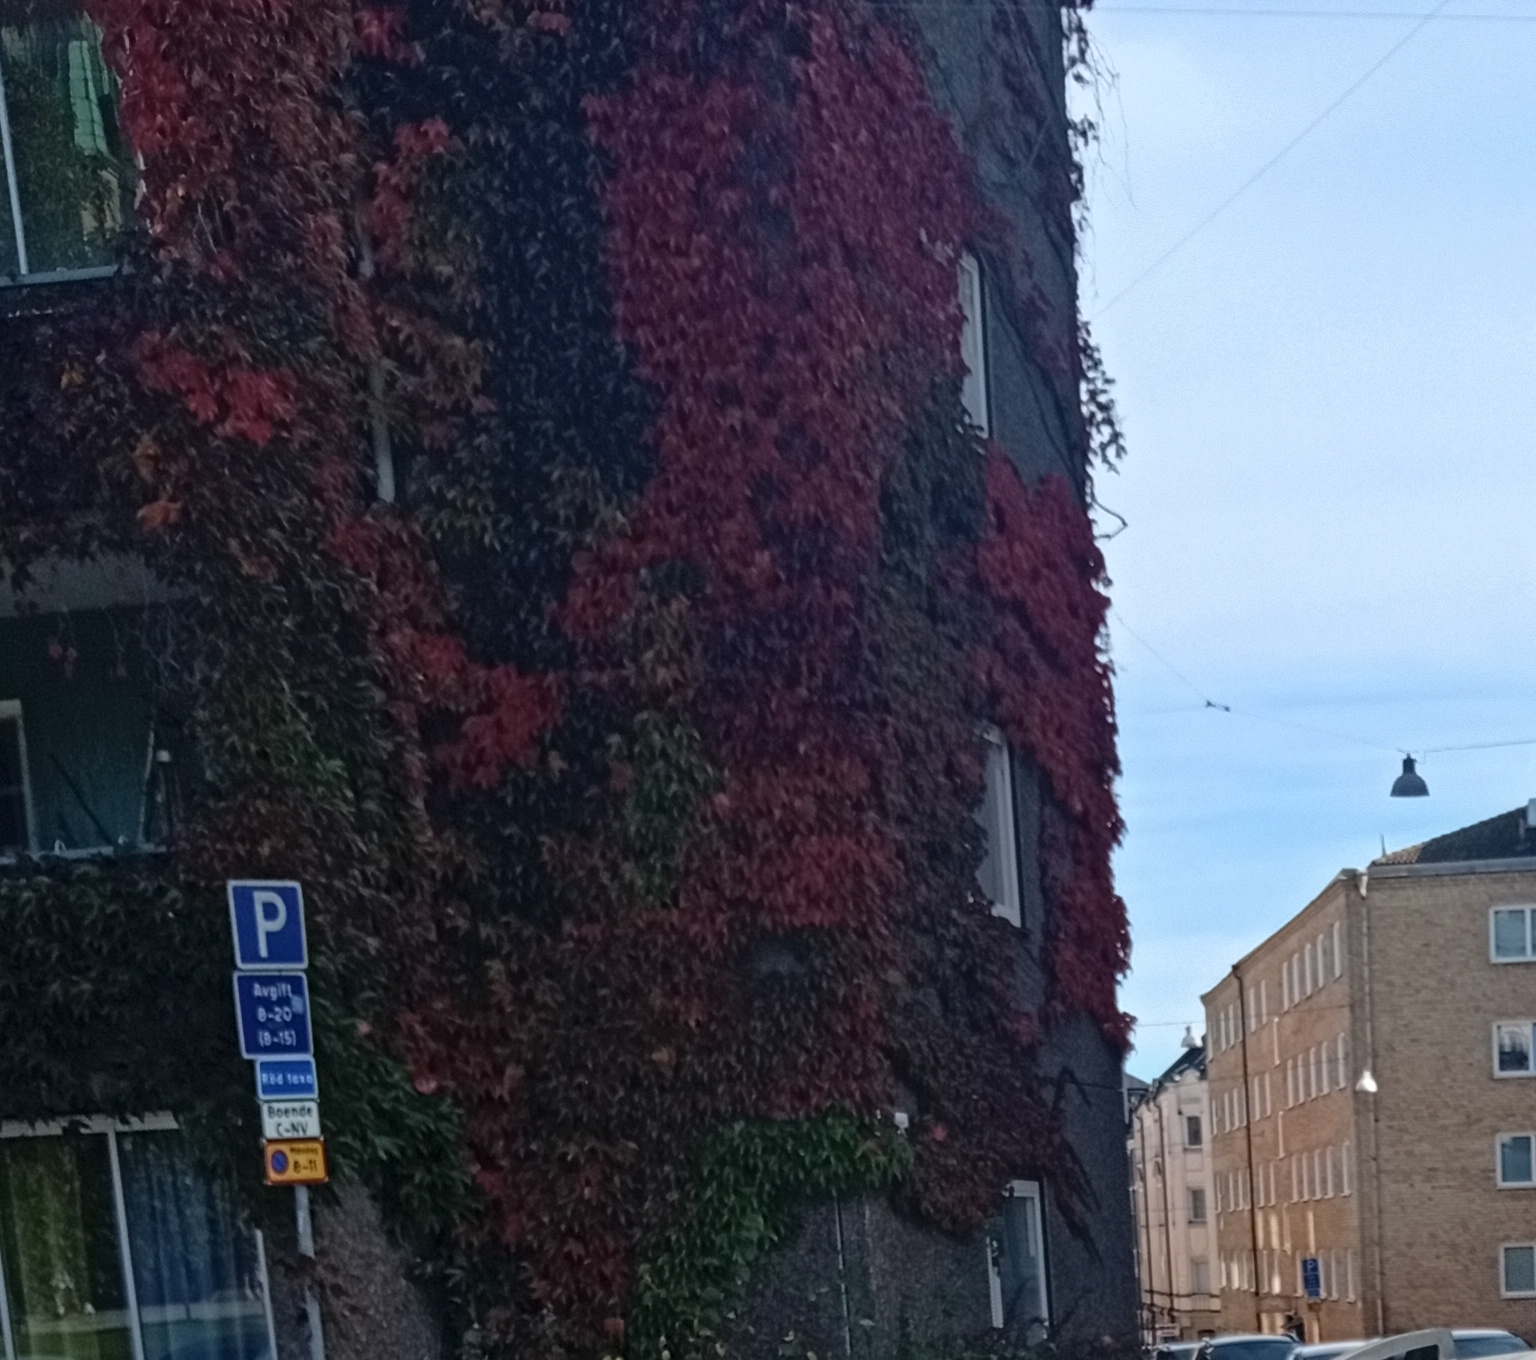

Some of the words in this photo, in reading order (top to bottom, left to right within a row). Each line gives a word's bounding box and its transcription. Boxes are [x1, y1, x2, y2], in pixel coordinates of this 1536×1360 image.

[252, 890, 287, 959] P
[253, 982, 292, 1001] Avgift
[258, 1006, 292, 1022] 8-20
[258, 1029, 296, 1047] (8-15)
[267, 1105, 314, 1119] Boende
[292, 1158, 318, 1174] 8-11
